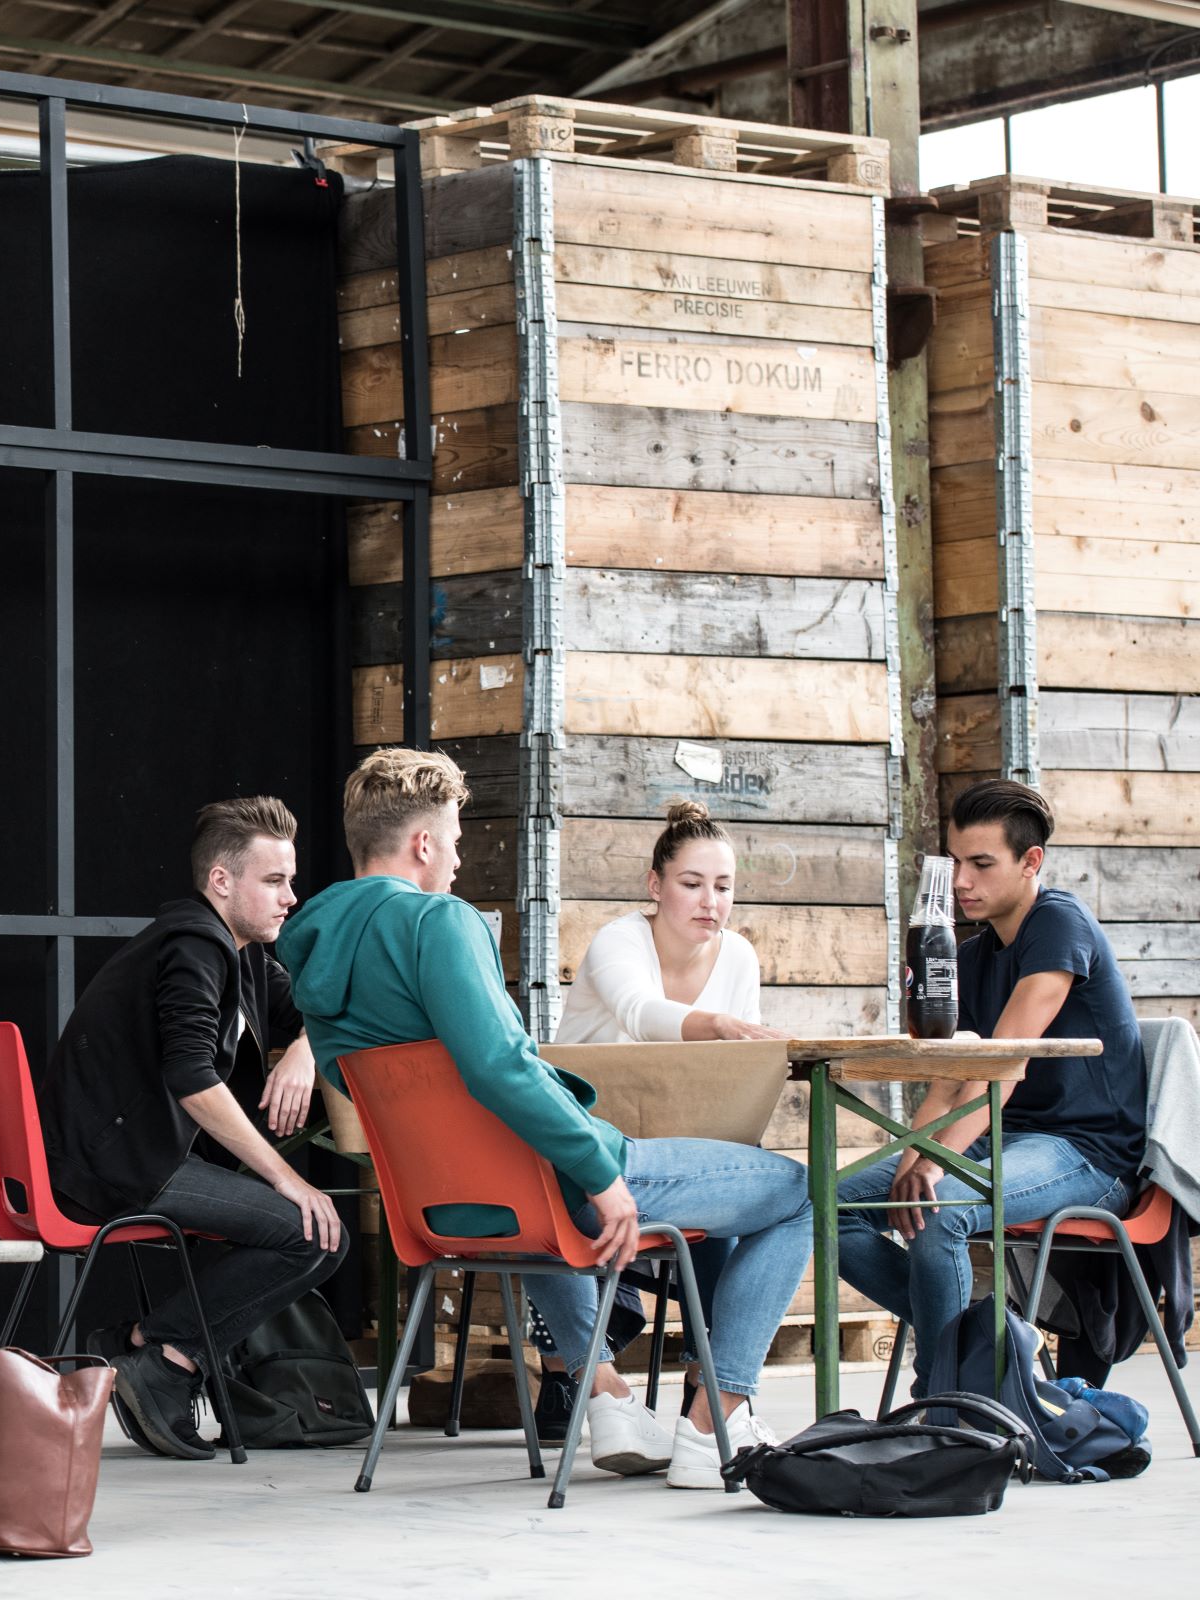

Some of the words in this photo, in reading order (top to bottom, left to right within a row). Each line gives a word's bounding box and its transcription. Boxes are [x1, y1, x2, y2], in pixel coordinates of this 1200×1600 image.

[660, 274, 692, 289] VAN
[697, 276, 772, 297] LEEUWEN
[673, 299, 744, 319] PRECISIE
[620, 351, 712, 383] FERRO
[726, 359, 823, 392] DOKUM
